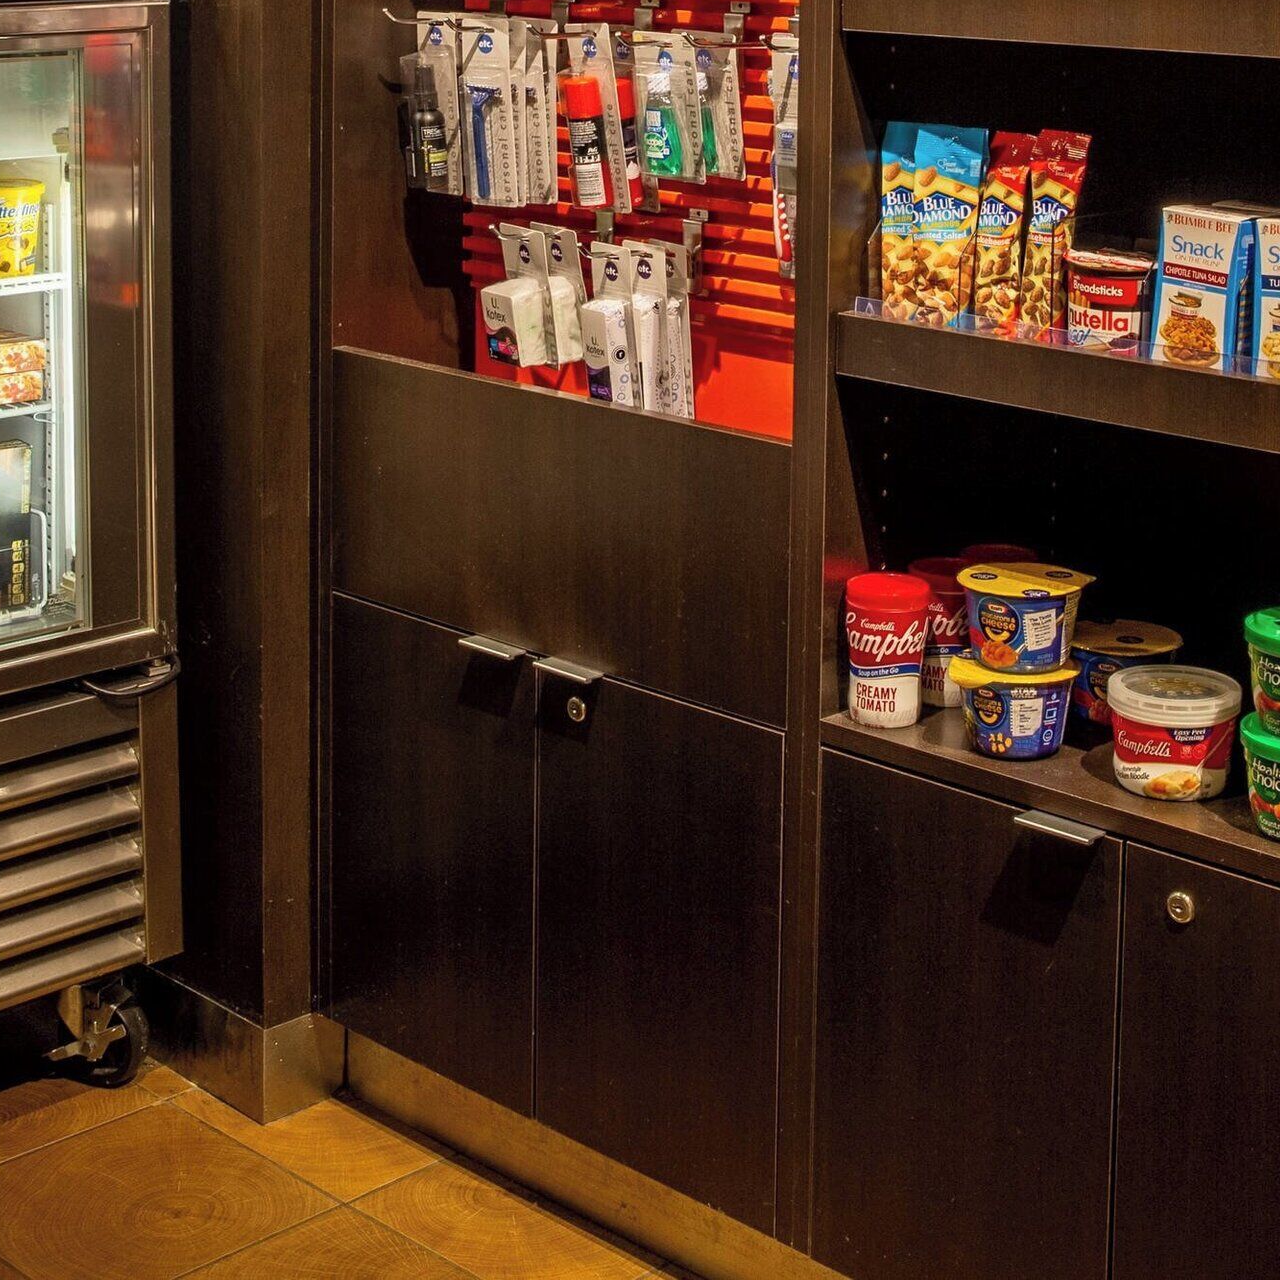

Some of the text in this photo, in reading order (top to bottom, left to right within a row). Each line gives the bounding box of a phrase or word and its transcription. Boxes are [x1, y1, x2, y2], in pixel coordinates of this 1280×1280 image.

[498, 99, 515, 203] personal care
[923, 196, 956, 212] BLUE
[981, 201, 1004, 216] BLUE
[1174, 214, 1233, 234] BUMBLE BEE
[1171, 234, 1225, 261] Snack
[1073, 279, 1124, 298] Breadsticks
[486, 309, 506, 324] kotex
[585, 343, 605, 357] kotex
[856, 683, 897, 701] CREAMY
[855, 696, 896, 714] TOMATO
[1118, 730, 1172, 758] Campbell's
